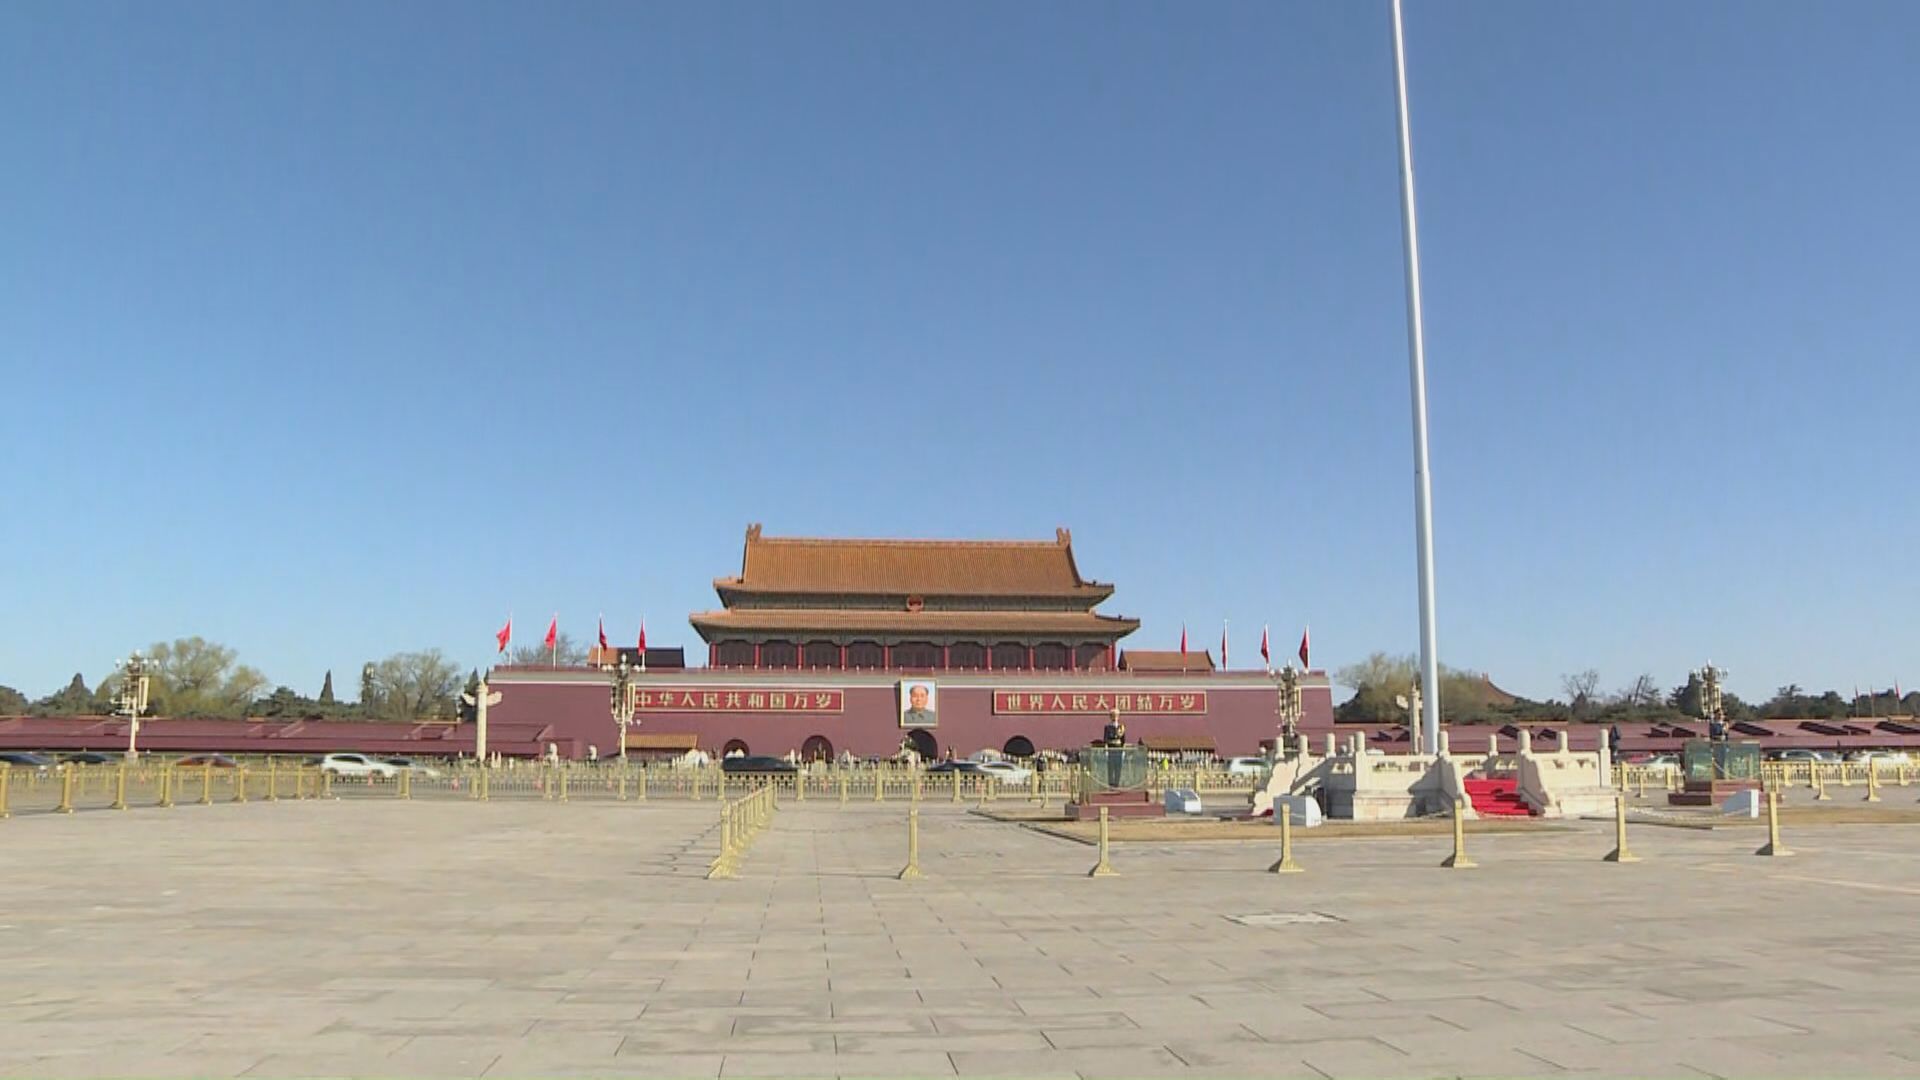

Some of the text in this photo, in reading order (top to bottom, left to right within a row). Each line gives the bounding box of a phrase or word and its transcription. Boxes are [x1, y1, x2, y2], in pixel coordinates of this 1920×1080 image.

[635, 692, 832, 709] 中华人民共和国万岁
[1007, 694, 1196, 711] 世界人民大团结万岁
